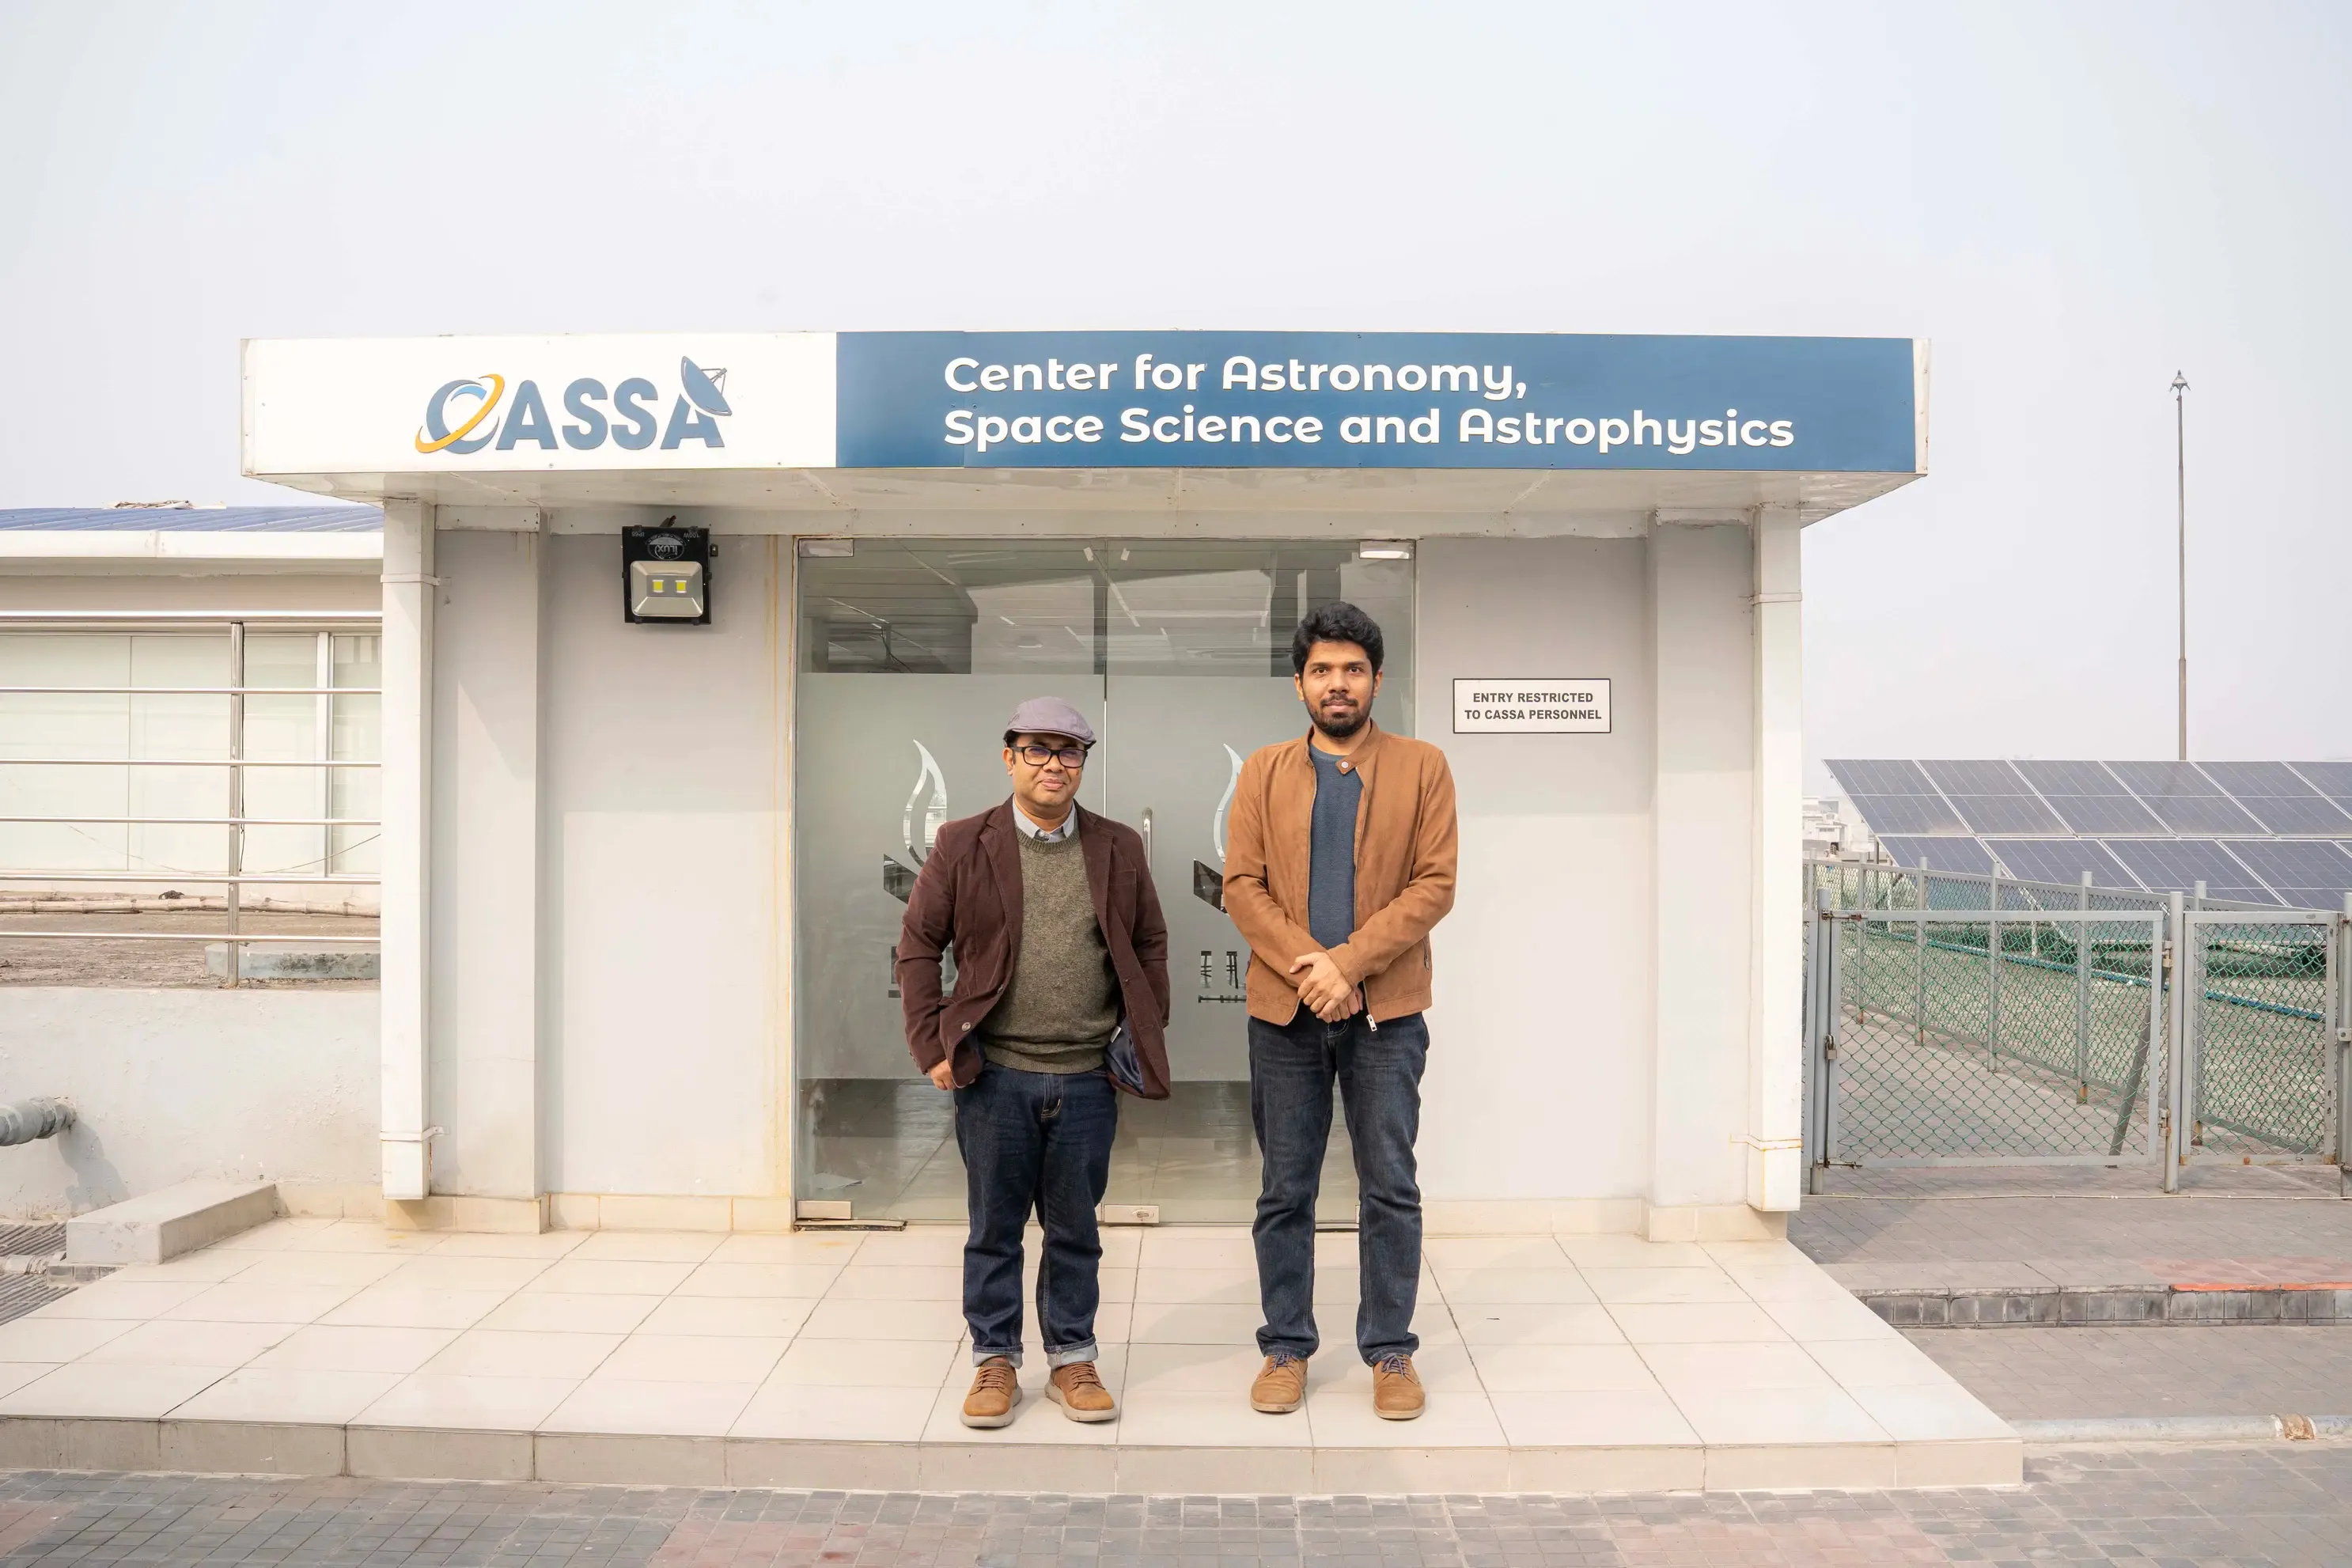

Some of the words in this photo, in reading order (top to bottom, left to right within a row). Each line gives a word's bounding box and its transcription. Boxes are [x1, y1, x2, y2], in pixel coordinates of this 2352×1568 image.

[945, 356, 1118, 392] Center
[1135, 353, 1206, 391] for
[1222, 354, 1528, 400] Astronomy,
[415, 372, 728, 454] CASSA
[943, 409, 1104, 452] Space
[1119, 404, 1324, 443] Science
[1339, 407, 1441, 444] and
[1459, 407, 1795, 453] Astrophysics
[1464, 709, 1481, 720] TO
[1484, 709, 1525, 720] CASSA
[1528, 709, 1602, 720] PERSONNEL
[1472, 692, 1513, 703] ENTRY
[1517, 692, 1593, 703] RESTRICTED
